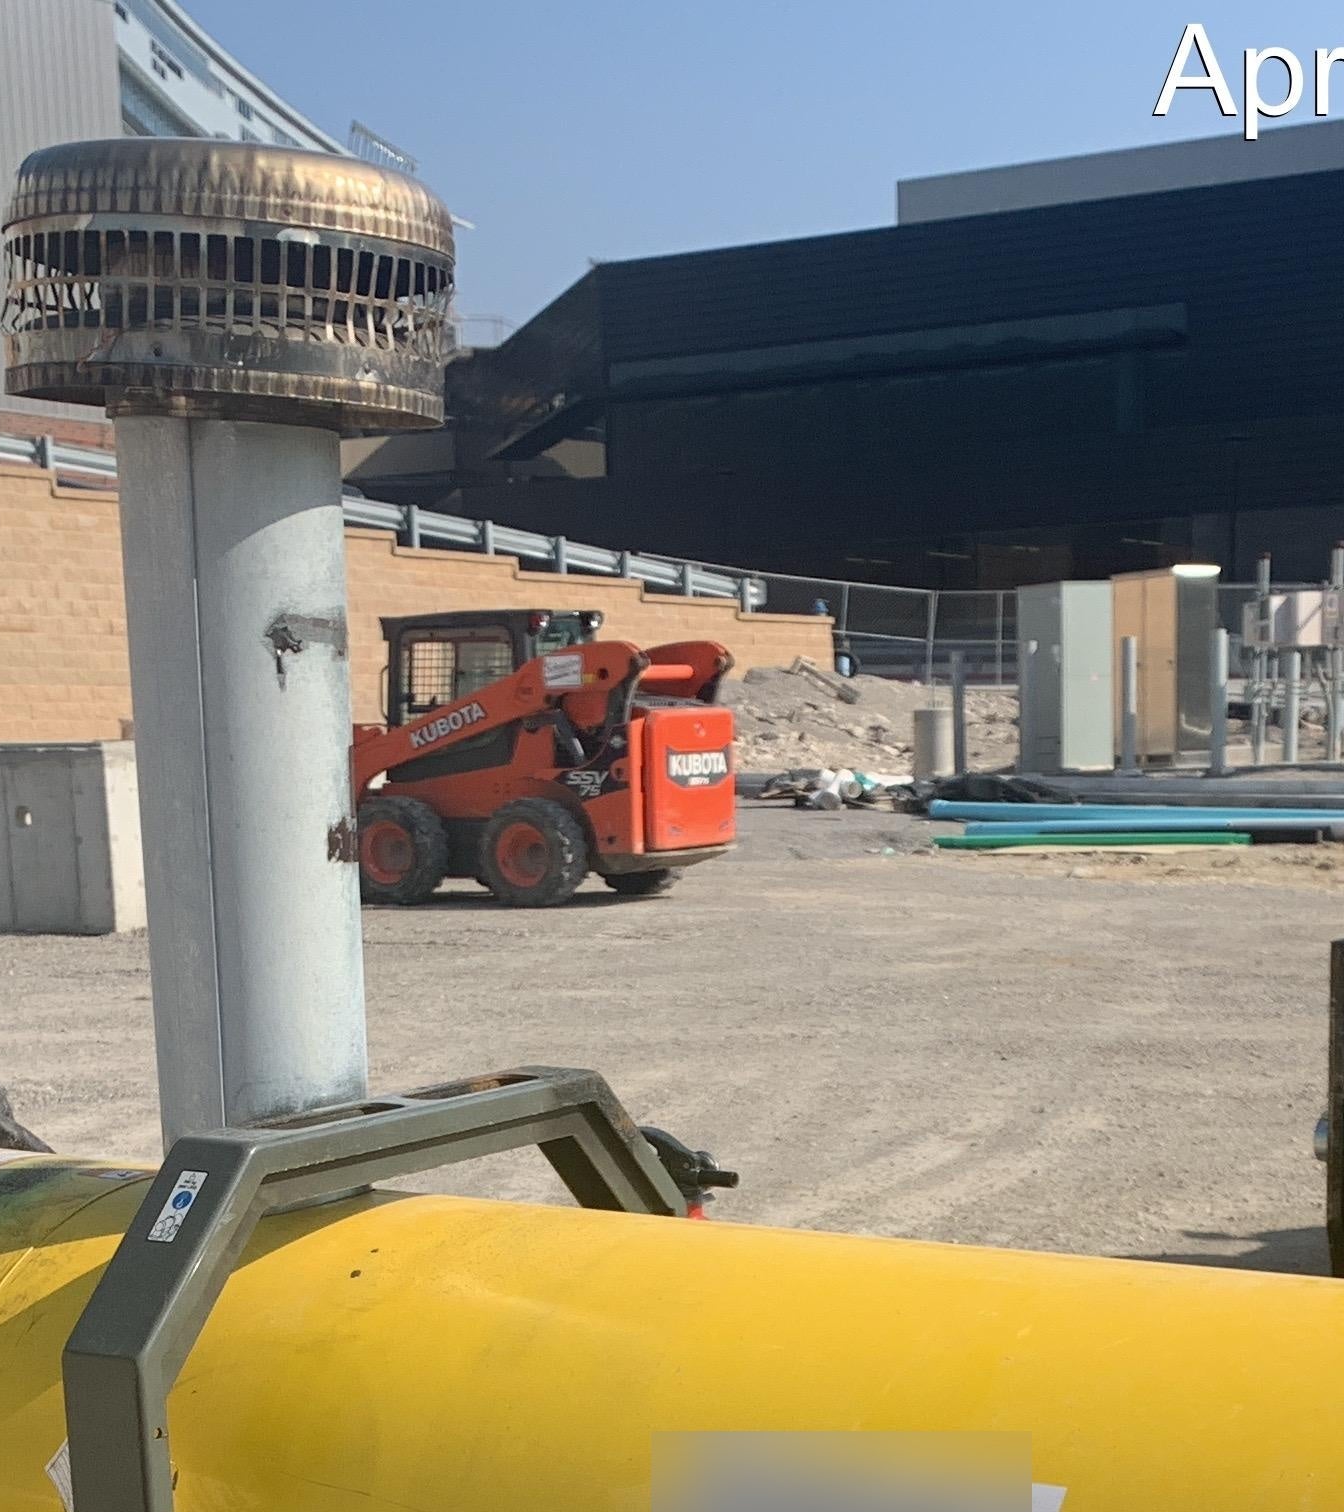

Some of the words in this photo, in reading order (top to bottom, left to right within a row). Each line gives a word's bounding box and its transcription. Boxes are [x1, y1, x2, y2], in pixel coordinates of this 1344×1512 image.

[408, 702, 487, 749] KUBOTA
[669, 752, 728, 776] KUBOTA
[566, 770, 610, 785] SSV
[579, 784, 601, 797] 75
